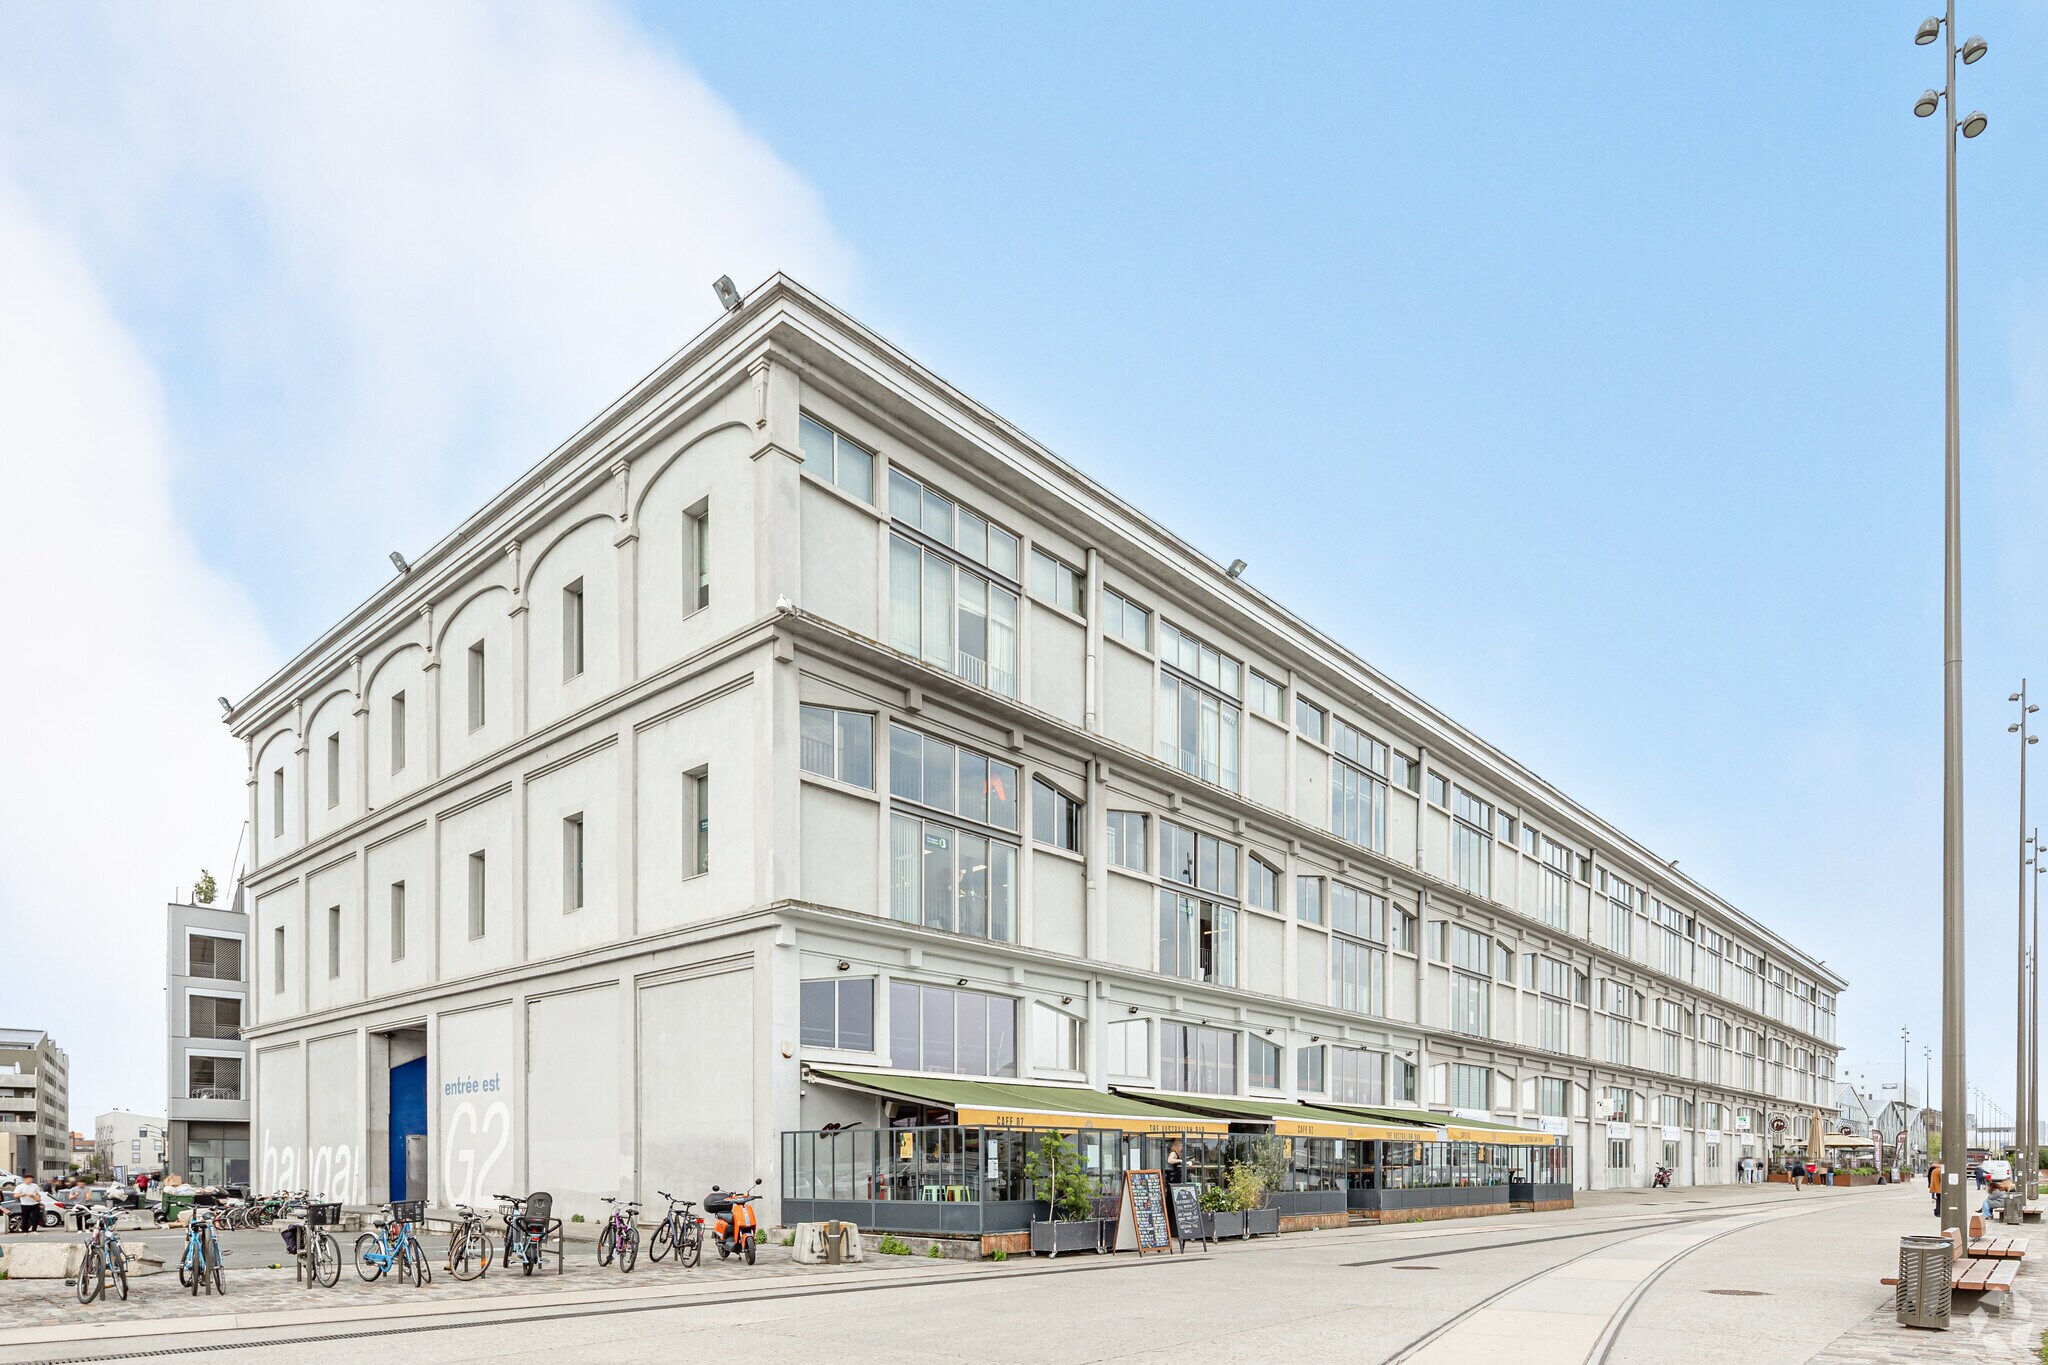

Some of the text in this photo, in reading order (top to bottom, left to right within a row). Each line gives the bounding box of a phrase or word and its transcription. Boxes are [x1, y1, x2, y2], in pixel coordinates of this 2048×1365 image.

[445, 1073, 500, 1096] entrée est
[445, 1101, 510, 1210] G2
